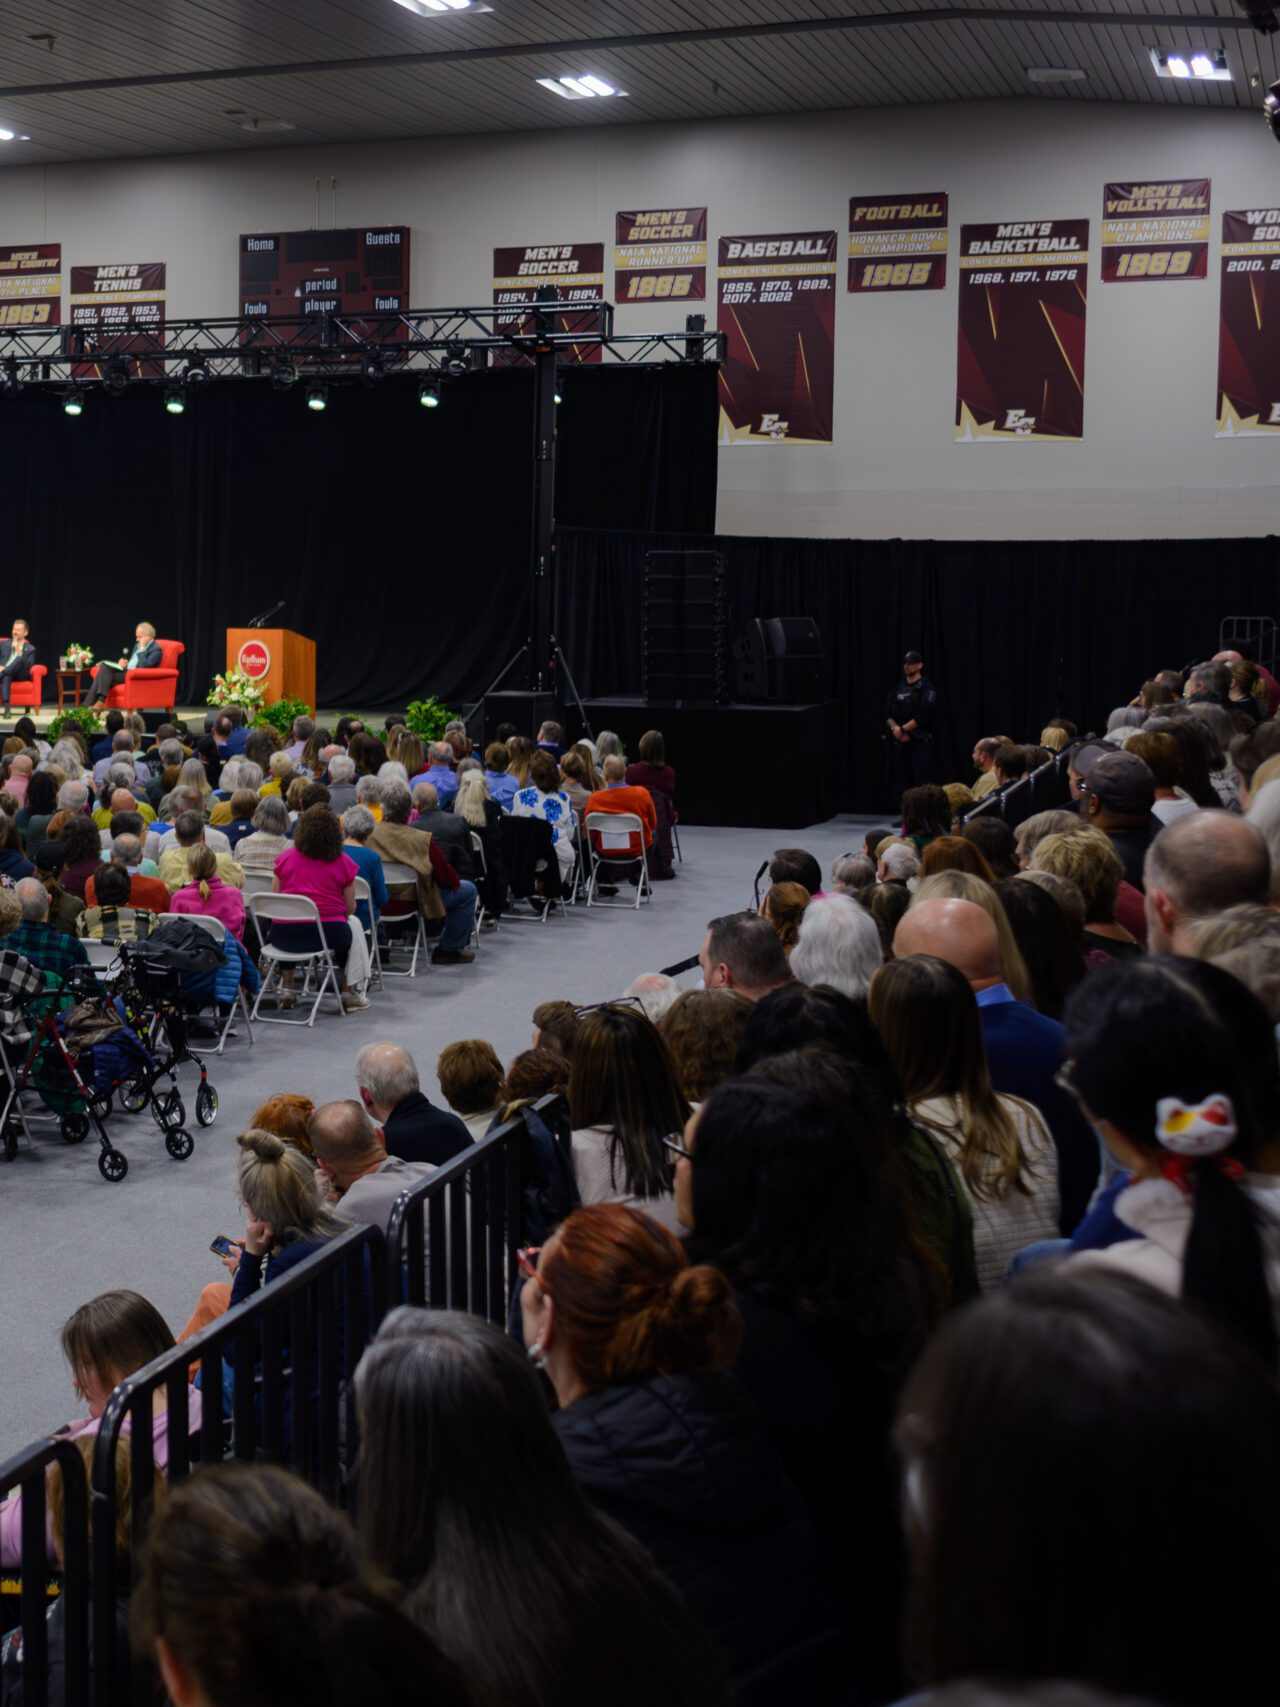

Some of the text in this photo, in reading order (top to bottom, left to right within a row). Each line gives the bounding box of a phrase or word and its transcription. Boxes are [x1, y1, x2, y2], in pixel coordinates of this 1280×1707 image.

[1131, 184, 1183, 199] MEN'S
[1106, 196, 1207, 213] VOLLEYBALL
[635, 211, 688, 226] MEN'S
[853, 203, 943, 222] FOOTBALL
[1246, 210, 1280, 225] WO
[628, 224, 695, 241] SOCCER
[996, 222, 1053, 238] MEN'S
[1107, 219, 1203, 233] NAIA NATIONAL
[1252, 226, 1280, 241] SO
[247, 231, 401, 252] Home Guests
[911, 232, 944, 241] BOWL
[1117, 231, 1193, 242] CHAMPIONS
[524, 246, 573, 261] MEN'S
[620, 245, 702, 257] NAIA NATIONAL
[727, 239, 828, 259] BASEBALL
[864, 242, 931, 254] CHAMPIONS
[968, 237, 1081, 255] BASKETBALL
[963, 254, 1085, 265] CONFERENCE CHAMPIONS
[1115, 251, 1193, 277] 1969
[96, 265, 139, 279] MEN'S
[518, 260, 580, 276] SOCCER
[720, 263, 833, 276] CONFERENCE CHAMPIONS
[861, 262, 933, 288] 1965
[1045, 269, 1078, 281] 1976
[15, 278, 56, 287] NATIONAL
[93, 278, 143, 292] TENNIS
[305, 278, 337, 294] period
[553, 275, 600, 284] CHAMPIONS
[19, 286, 48, 295] PLACE
[759, 292, 793, 303] 2022
[245, 296, 399, 315] fouls fouls
[305, 299, 337, 315] player
[0, 303, 51, 325] 1963
